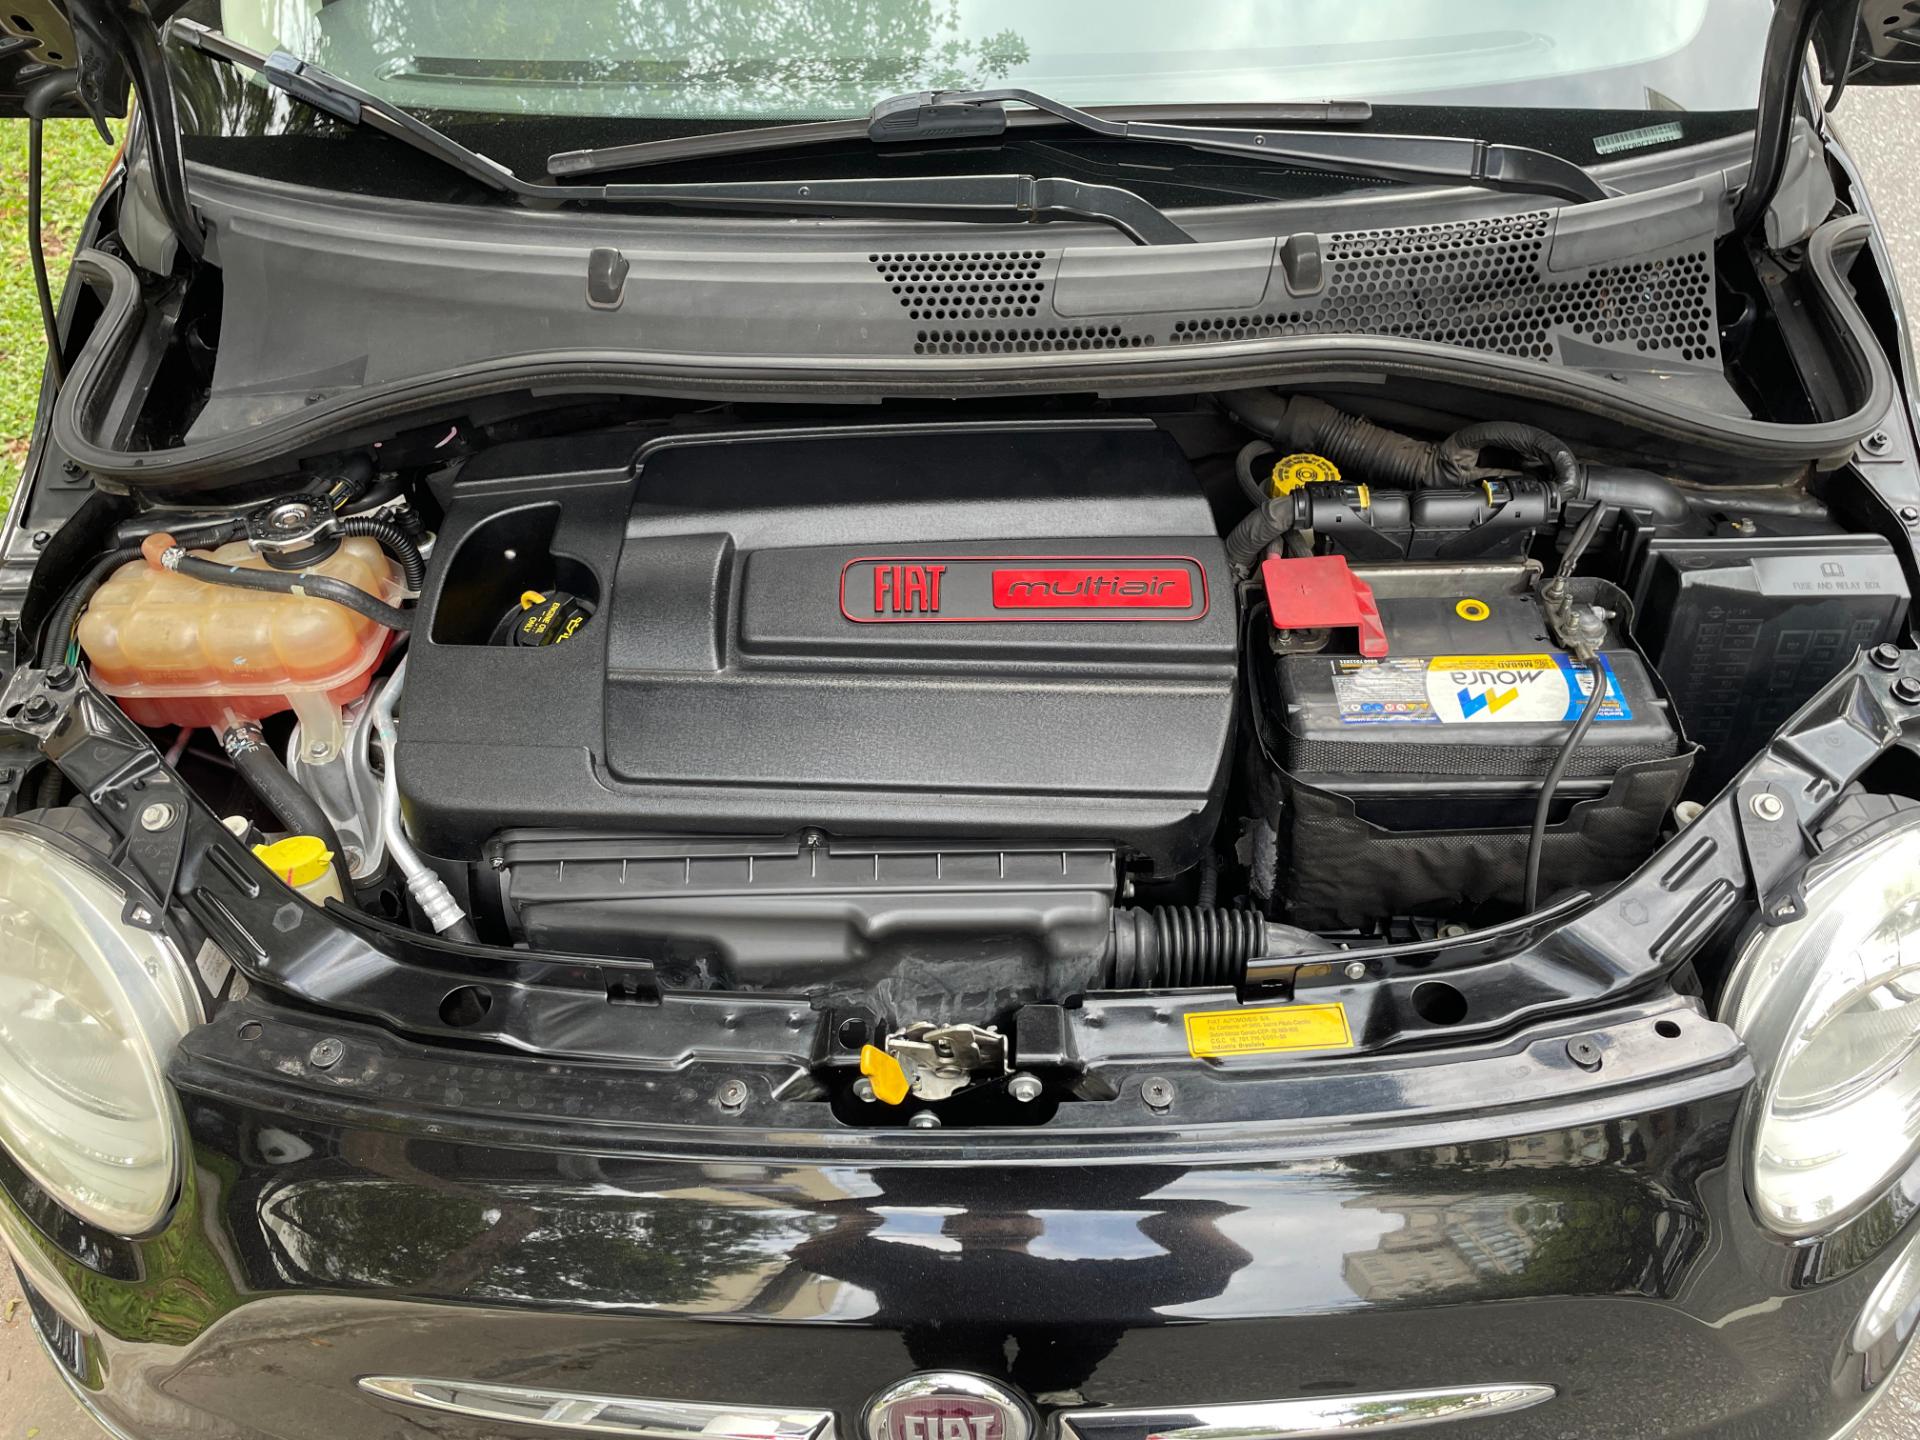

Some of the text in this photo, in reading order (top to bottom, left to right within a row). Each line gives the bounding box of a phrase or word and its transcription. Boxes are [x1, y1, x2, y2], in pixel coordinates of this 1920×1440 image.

[874, 566, 1176, 612] FIAT multiair
[1793, 581, 1881, 590] FUSE AND RELAY BOX
[523, 617, 537, 633] ONLY
[535, 602, 561, 634] ENGINE OIL
[904, 1415, 995, 1440] FIAT
